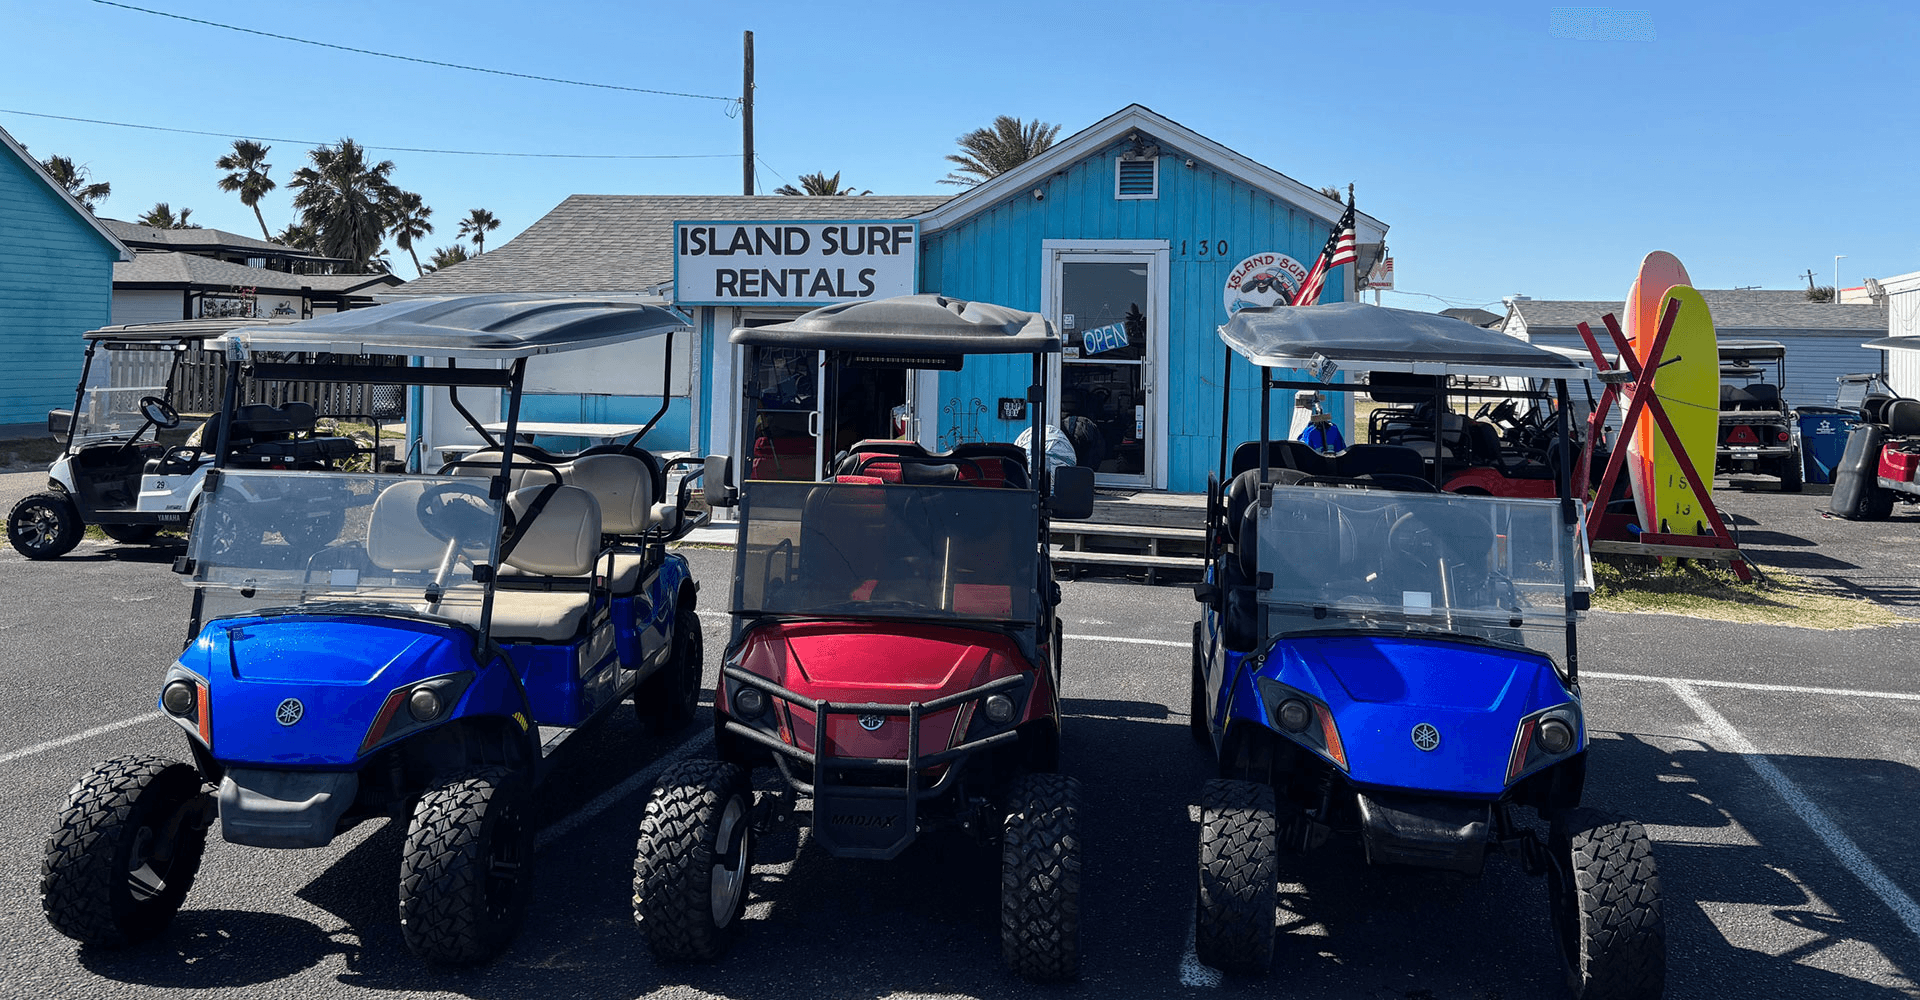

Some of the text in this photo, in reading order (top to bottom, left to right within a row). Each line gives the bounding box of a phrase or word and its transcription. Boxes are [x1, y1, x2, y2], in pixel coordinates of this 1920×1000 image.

[681, 226, 914, 256] ISLAND SURF
[1182, 240, 1229, 256] 130
[715, 268, 876, 298] RENTALS
[1228, 255, 1306, 290] ISLAND SUR
[1084, 323, 1128, 353] OPEN
[156, 481, 165, 489] 29
[1676, 503, 1690, 515] 13
[832, 815, 899, 829] MADJAX
